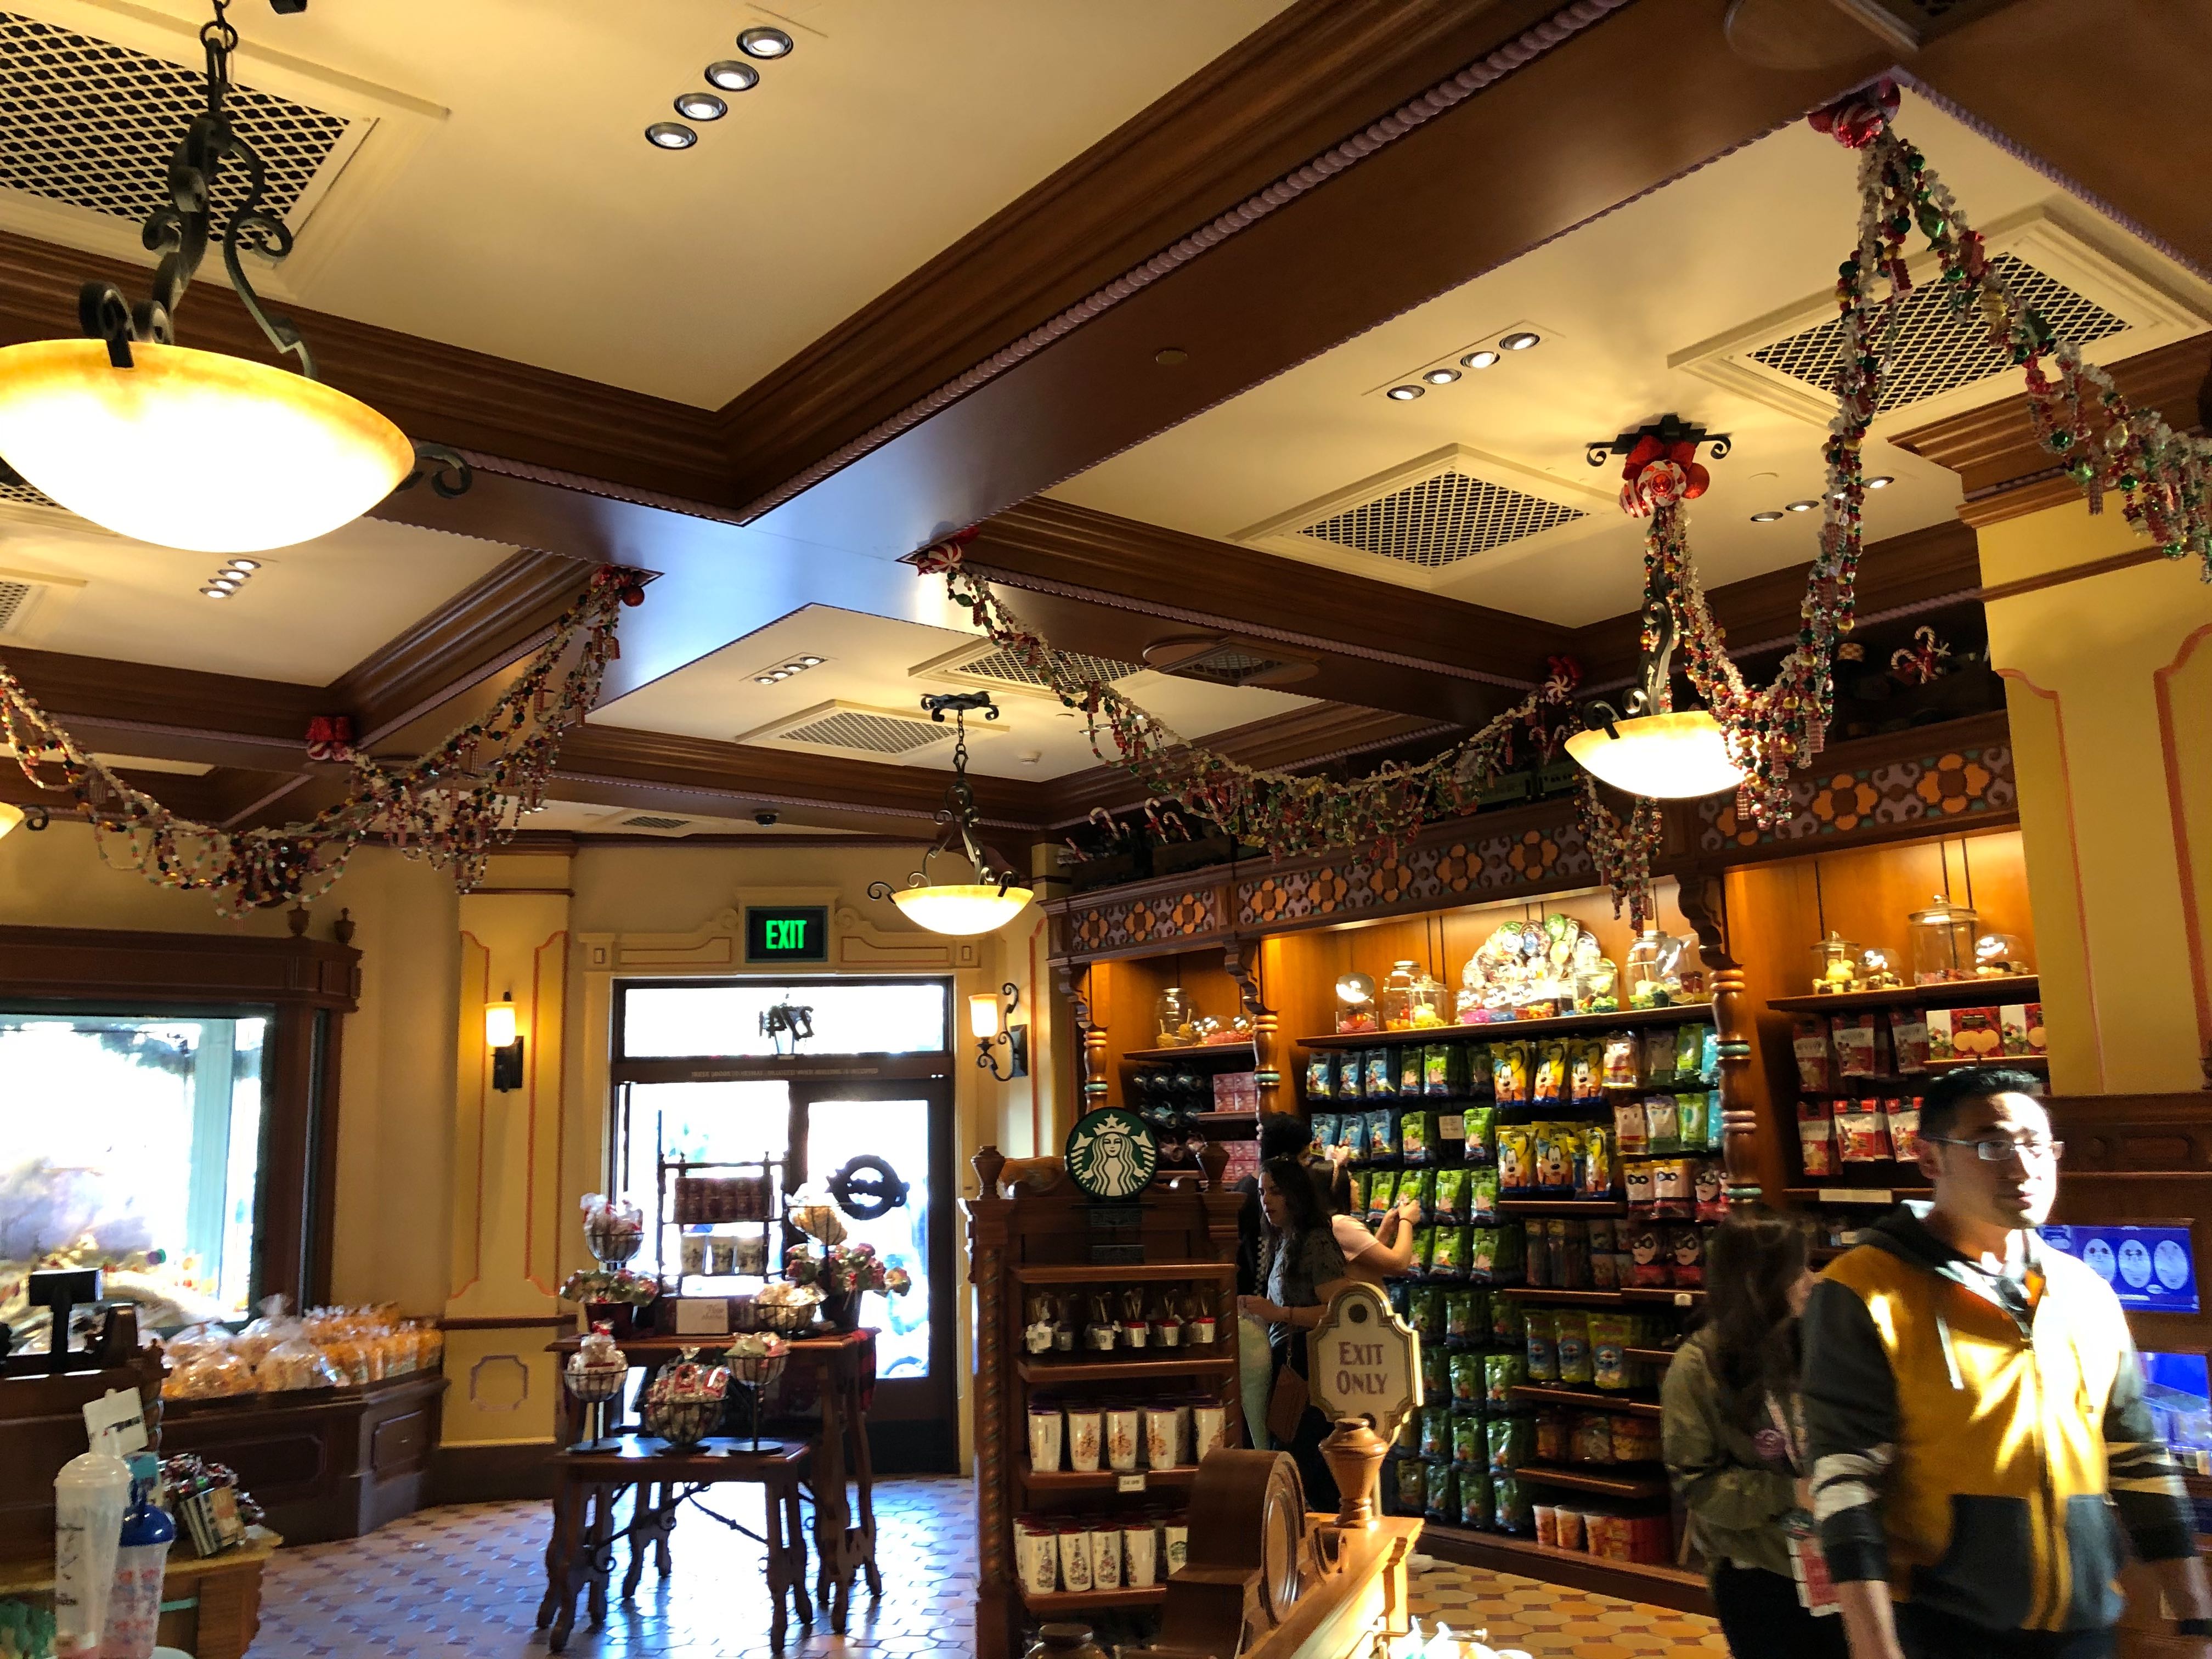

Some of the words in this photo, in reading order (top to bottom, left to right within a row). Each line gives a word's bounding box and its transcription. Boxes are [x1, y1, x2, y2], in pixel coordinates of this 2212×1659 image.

[766, 920, 807, 949] EXIT
[1338, 1341, 1384, 1365] EXIT
[1336, 1370, 1388, 1395] ONLY
